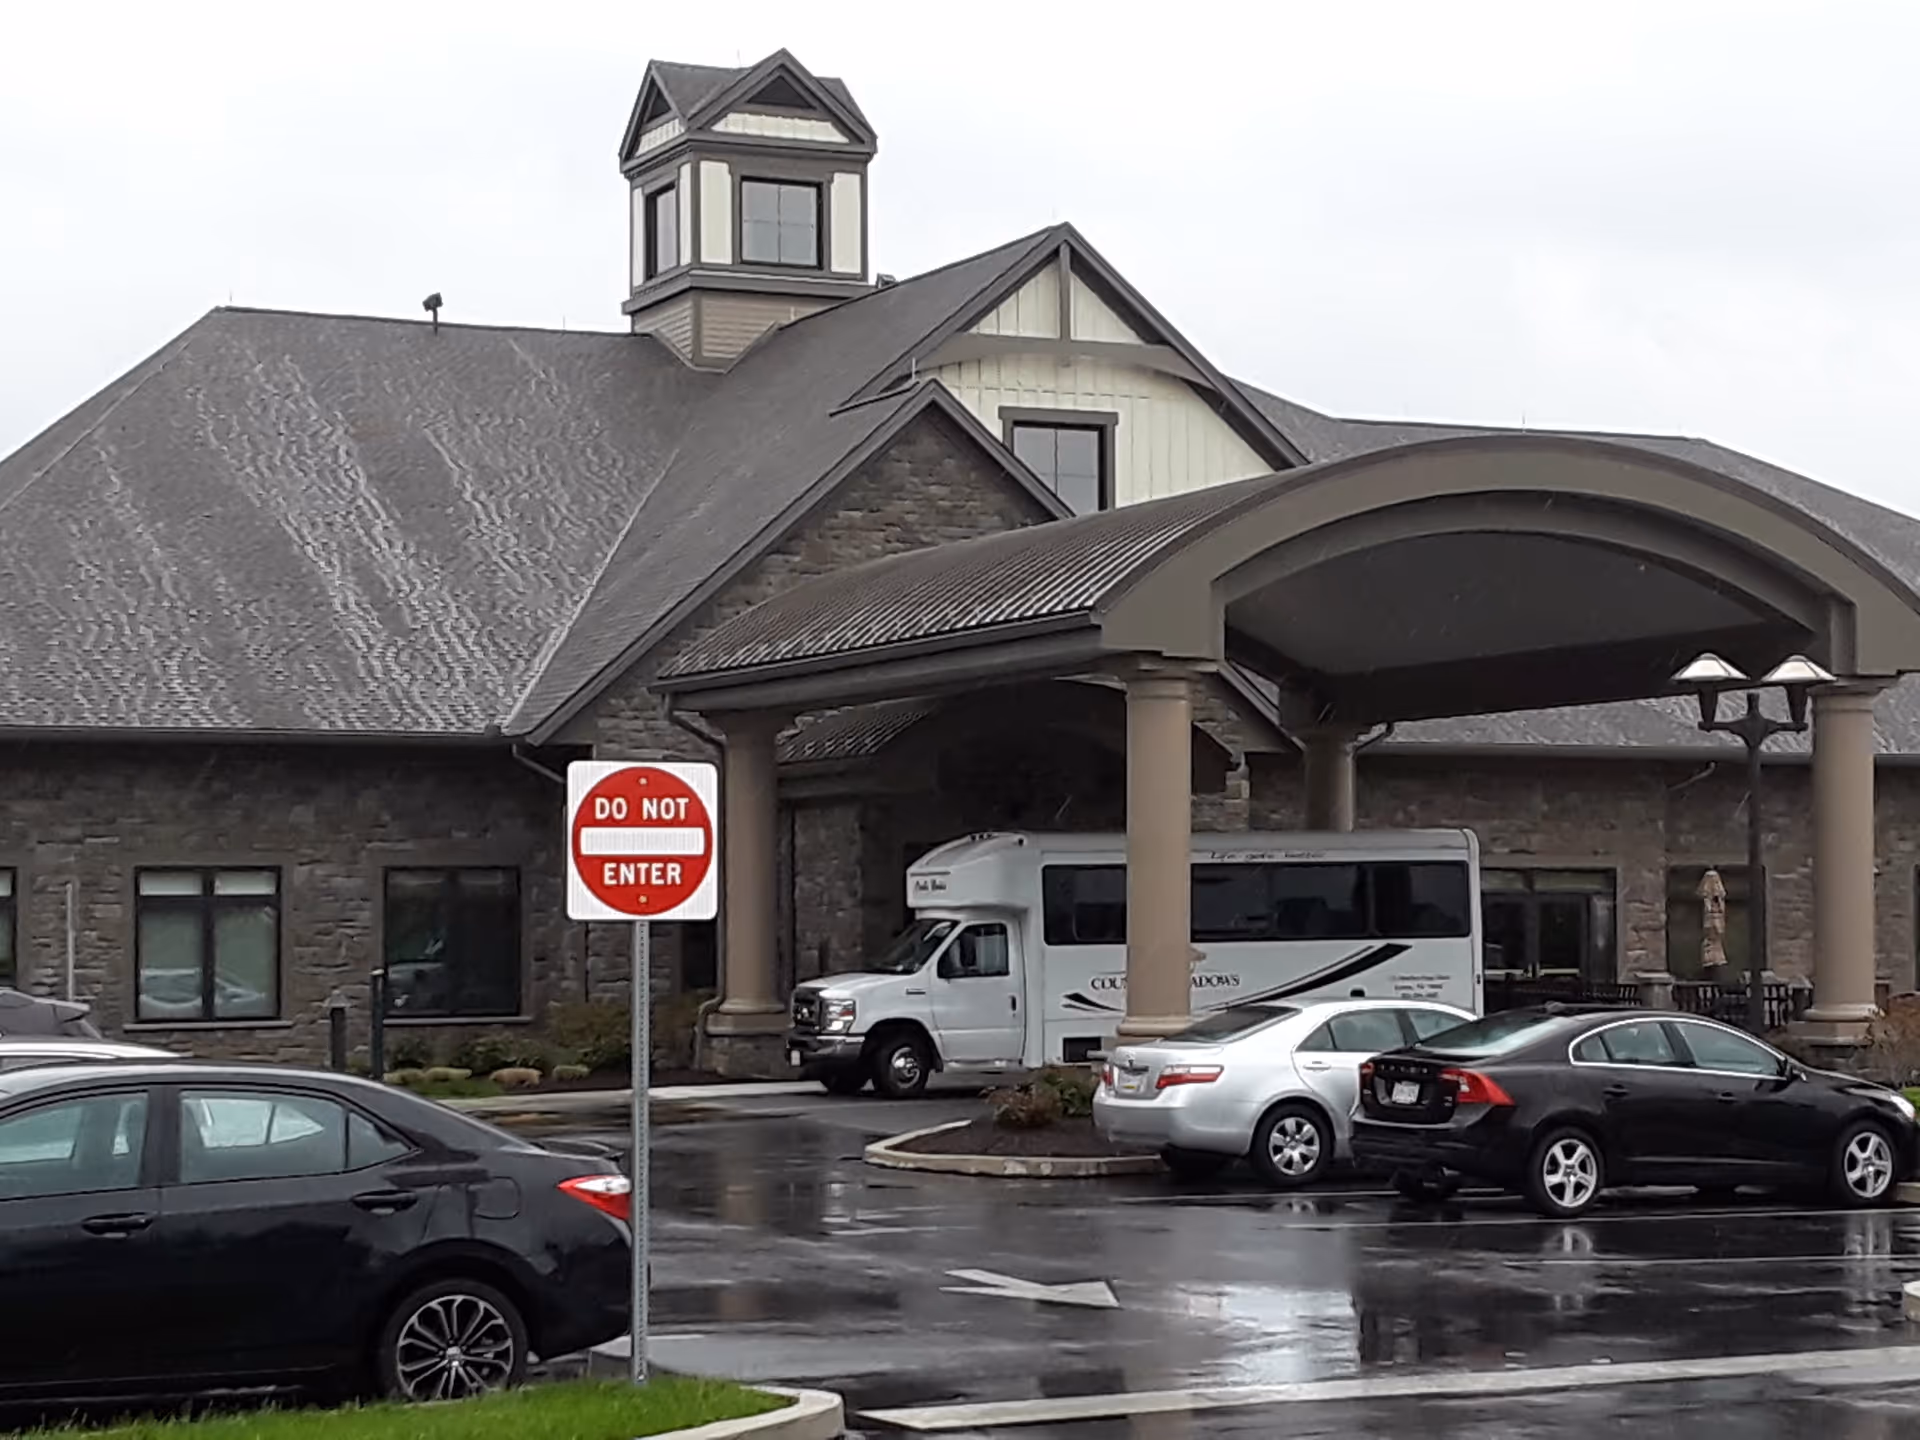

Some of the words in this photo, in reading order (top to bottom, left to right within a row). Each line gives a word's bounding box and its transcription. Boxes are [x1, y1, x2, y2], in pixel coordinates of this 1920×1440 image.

[594, 797, 628, 820] DO
[641, 797, 690, 821] NOT
[603, 862, 683, 886] ENTER
[1190, 974, 1241, 989] ADOWS
